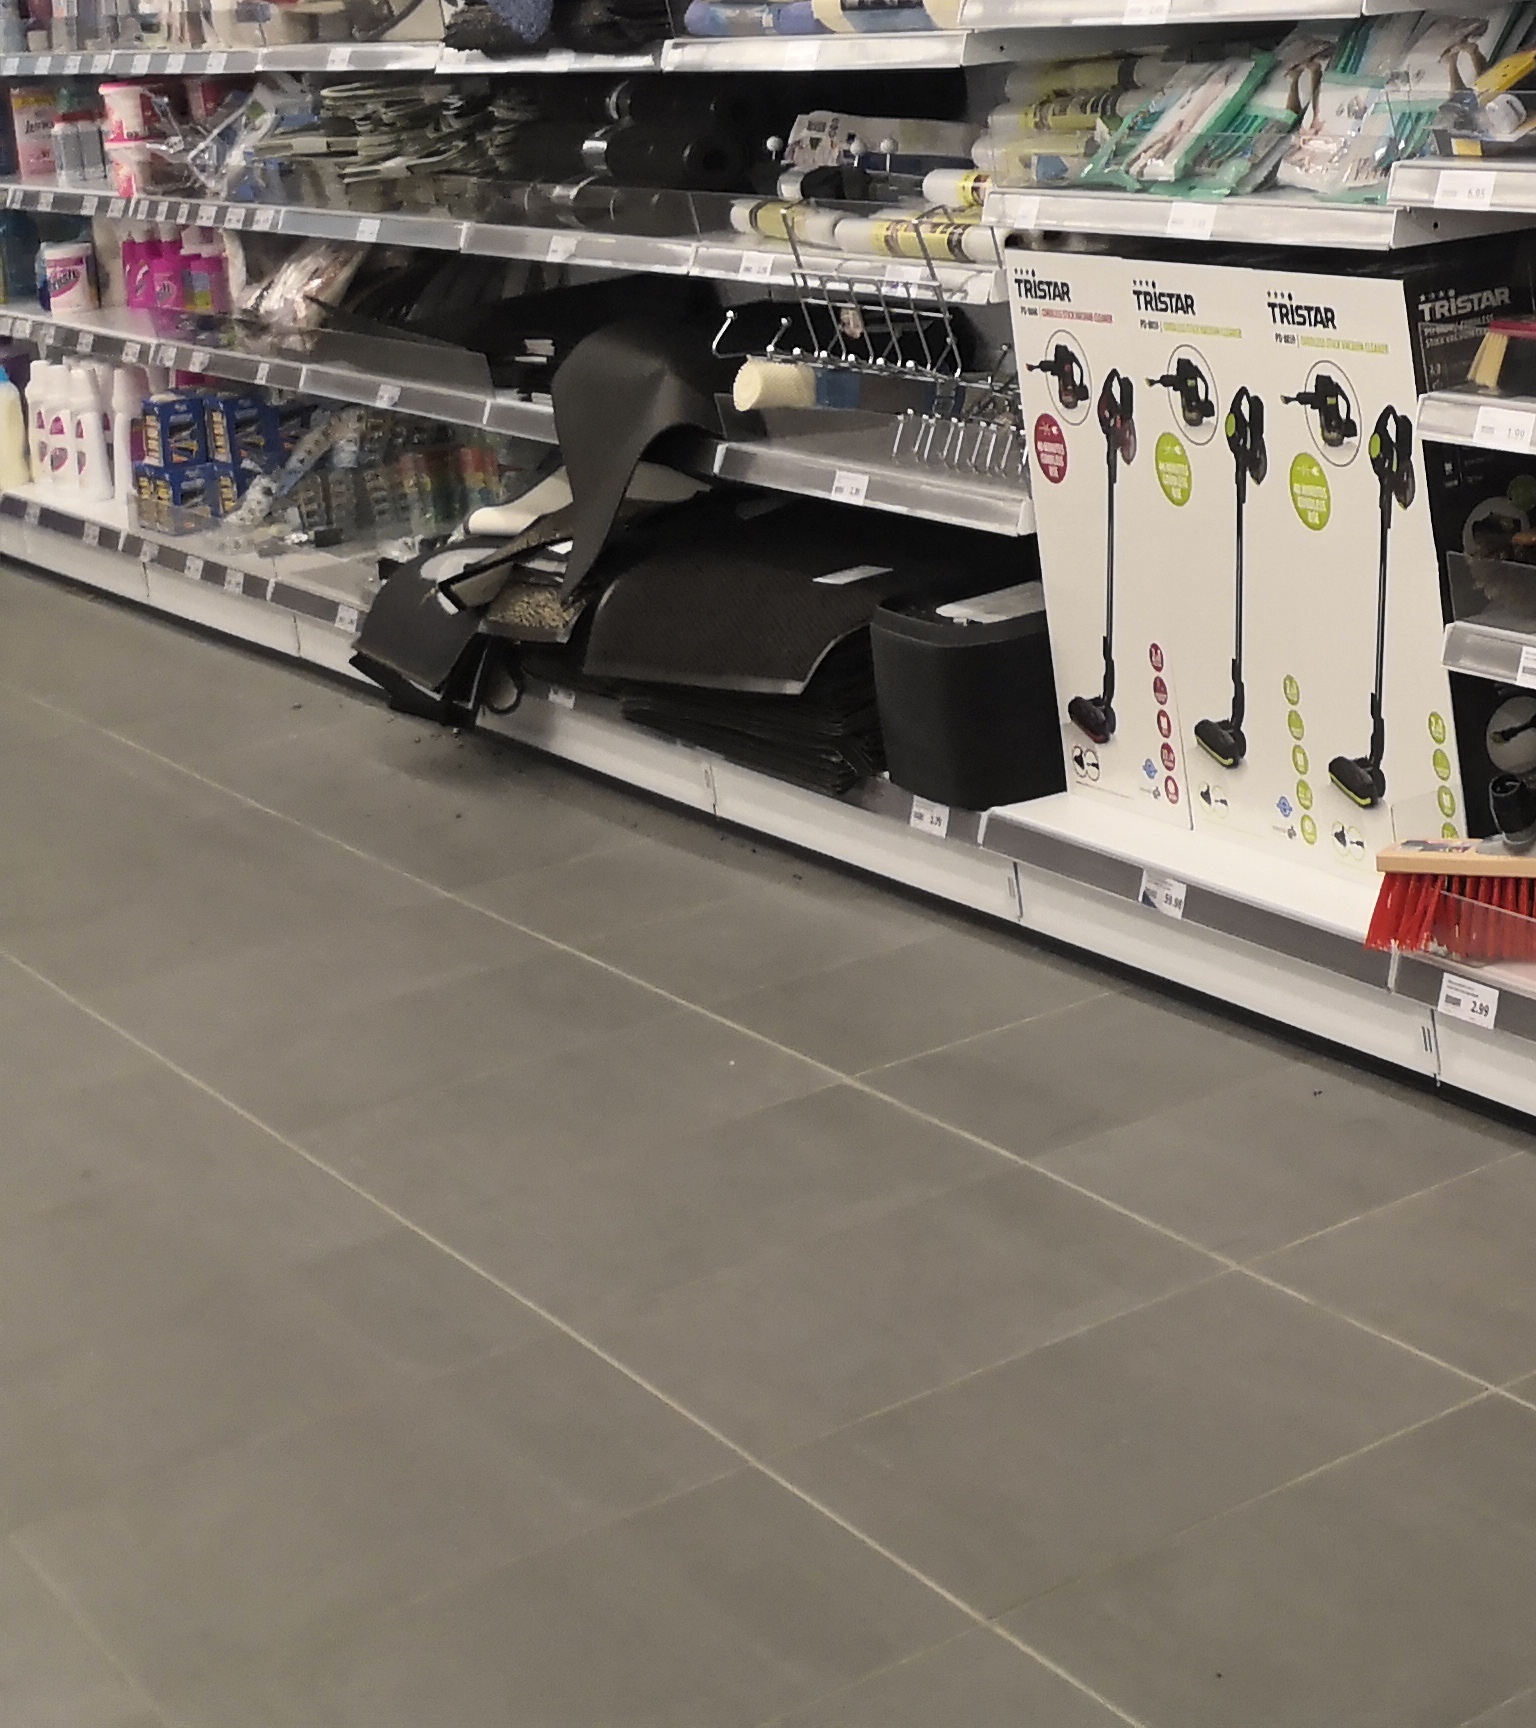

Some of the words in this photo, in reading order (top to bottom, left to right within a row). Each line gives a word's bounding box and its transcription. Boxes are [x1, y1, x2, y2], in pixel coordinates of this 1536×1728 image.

[1014, 270, 1072, 302] TRISTAR
[1133, 281, 1196, 315] TRISTAR
[1268, 292, 1337, 330] TRISTAR
[1418, 286, 1511, 321] TRISTAR
[1507, 428, 1525, 440] 1.99
[1470, 1000, 1490, 1018] 2.99
